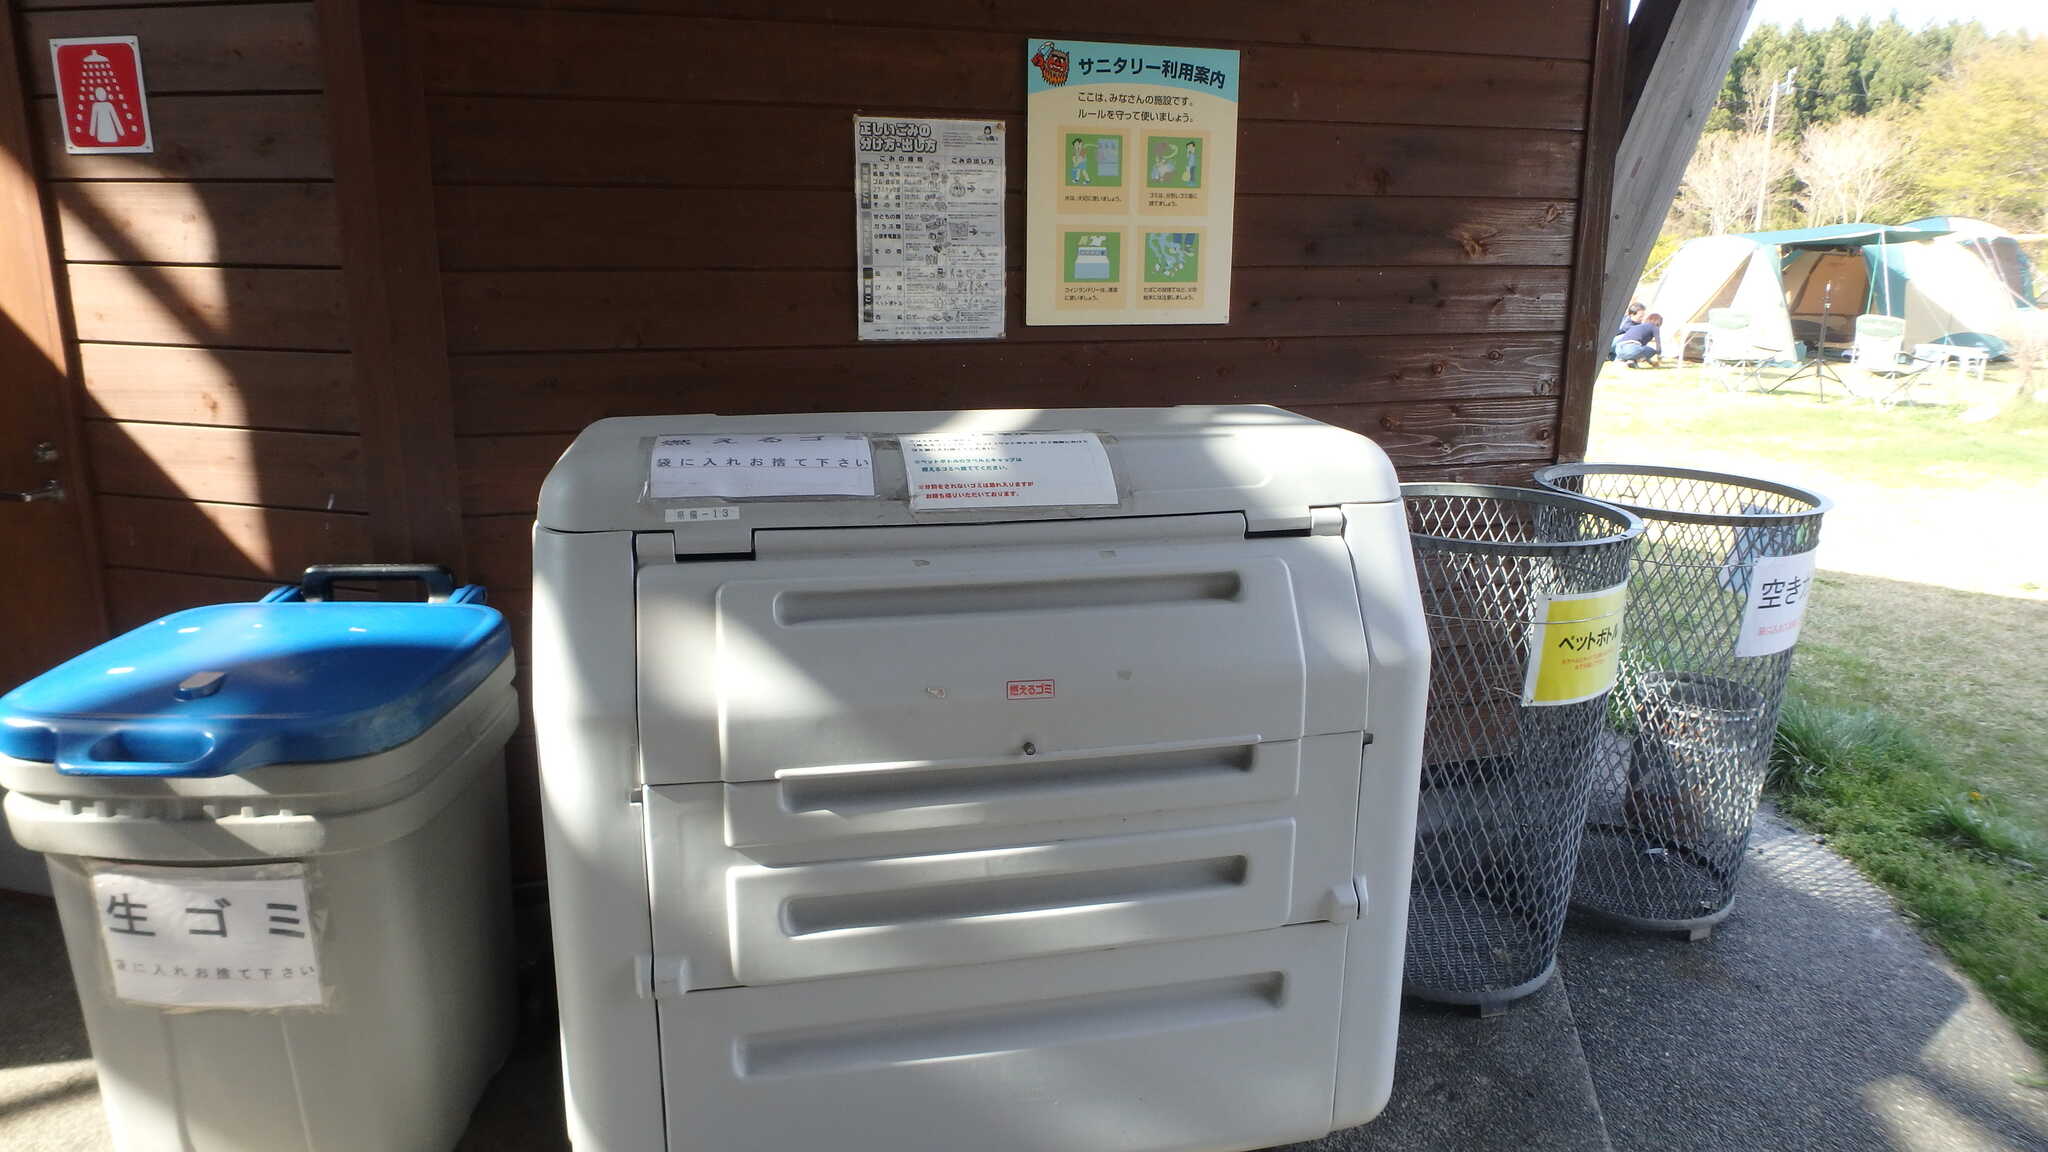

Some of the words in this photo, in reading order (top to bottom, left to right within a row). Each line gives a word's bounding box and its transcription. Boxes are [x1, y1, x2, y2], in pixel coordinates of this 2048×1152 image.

[1078, 58, 1226, 89] サニタリー利用案内
[1077, 91, 1193, 107] ここは、みなさんの施設です。
[1077, 109, 1193, 123] ルールを守って使いましょう。
[656, 457, 870, 468] 袋に入れお捨て下さい
[1757, 575, 1810, 609] 空き
[1009, 682, 1053, 696] 燃えるゴミ
[106, 893, 305, 938] 生ゴミ
